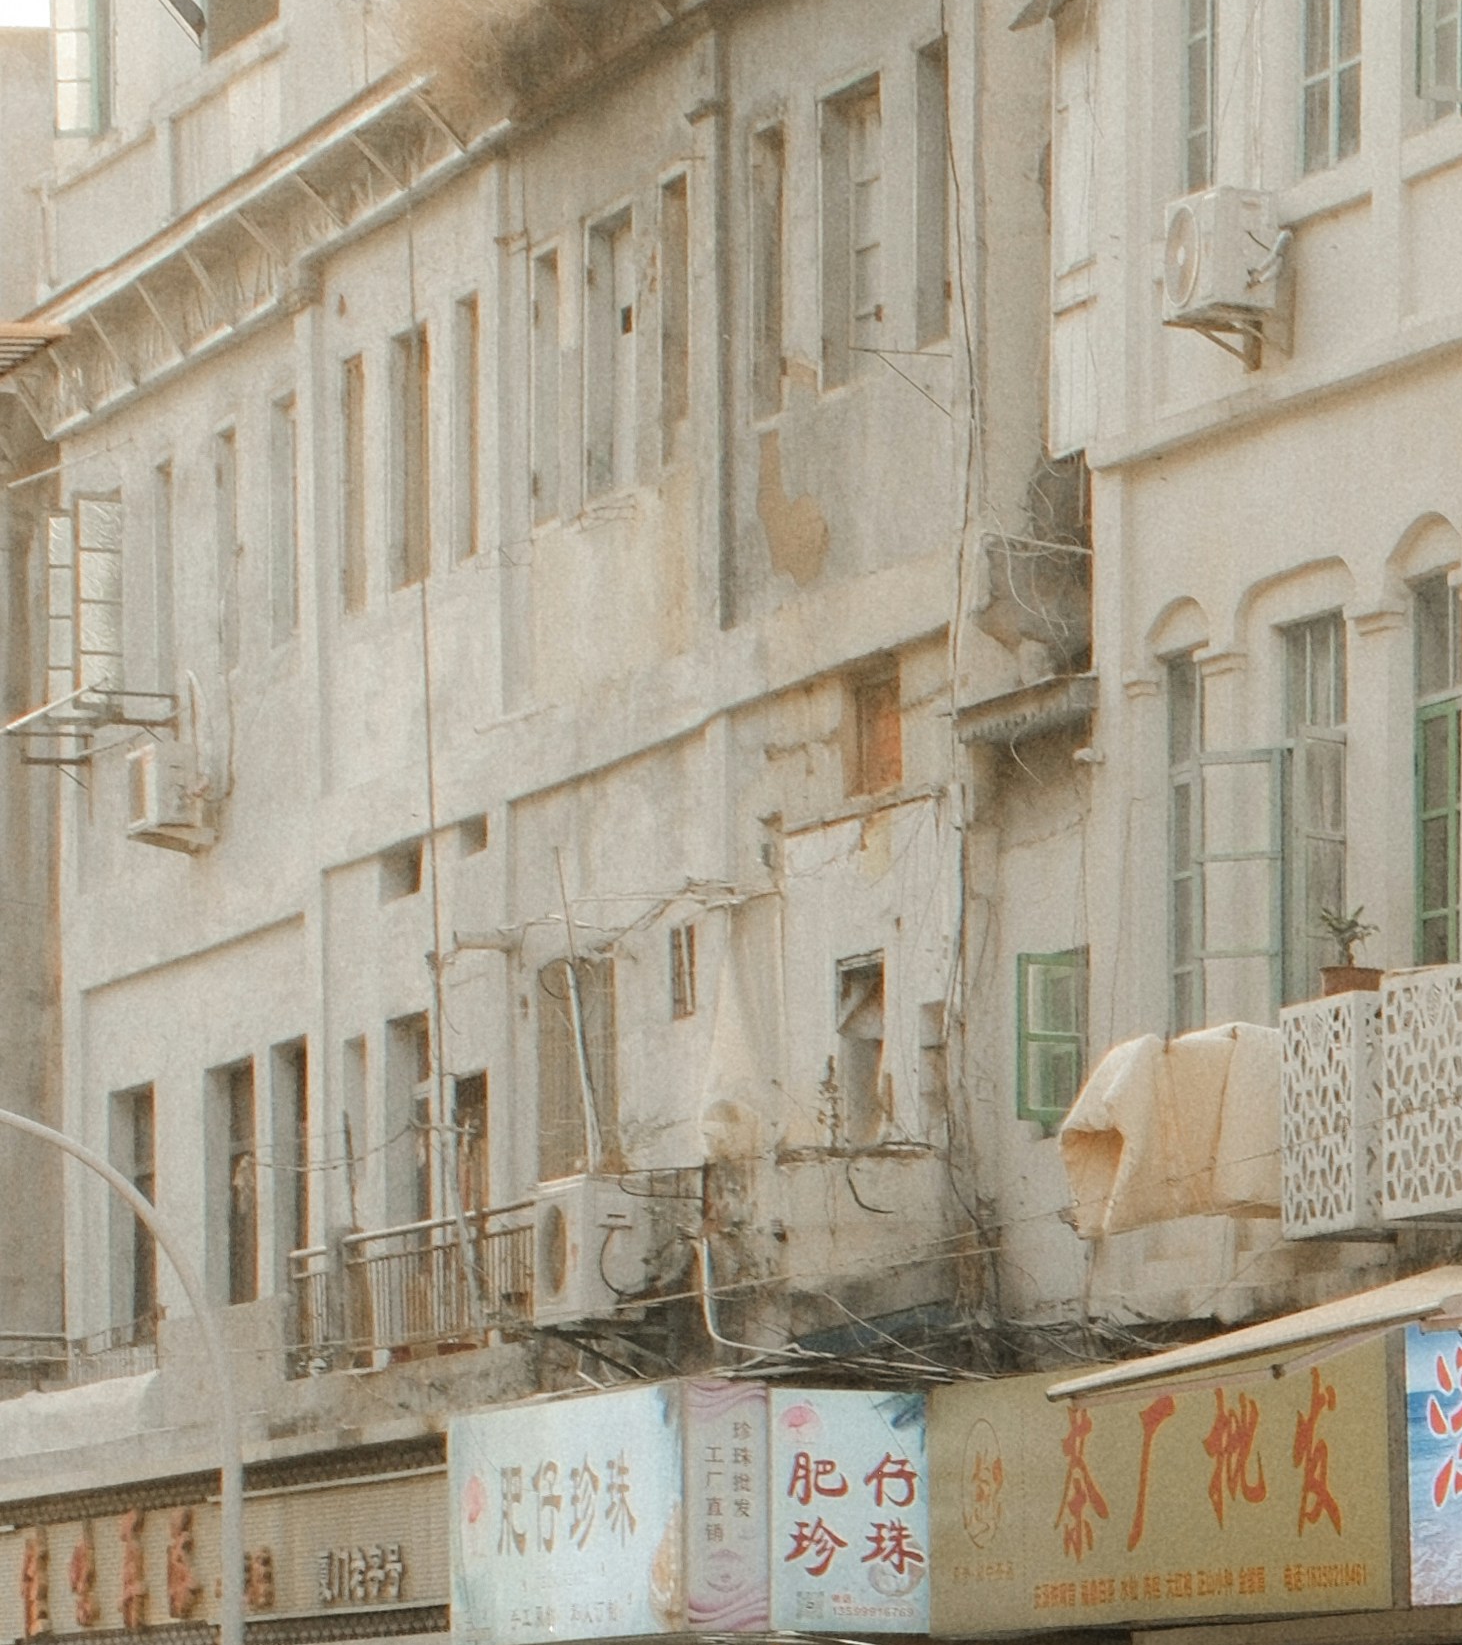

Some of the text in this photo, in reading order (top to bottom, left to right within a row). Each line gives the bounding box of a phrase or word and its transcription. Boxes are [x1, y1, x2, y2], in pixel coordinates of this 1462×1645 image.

[498, 1449, 637, 1556] 肥仔珍珠
[704, 1446, 723, 1542] 工厂直销
[733, 1421, 752, 1518] 珍珠批发
[787, 1451, 918, 1507] 肥仔
[1055, 1366, 1342, 1563] 茶厂批发
[784, 1516, 925, 1577] 珍珠
